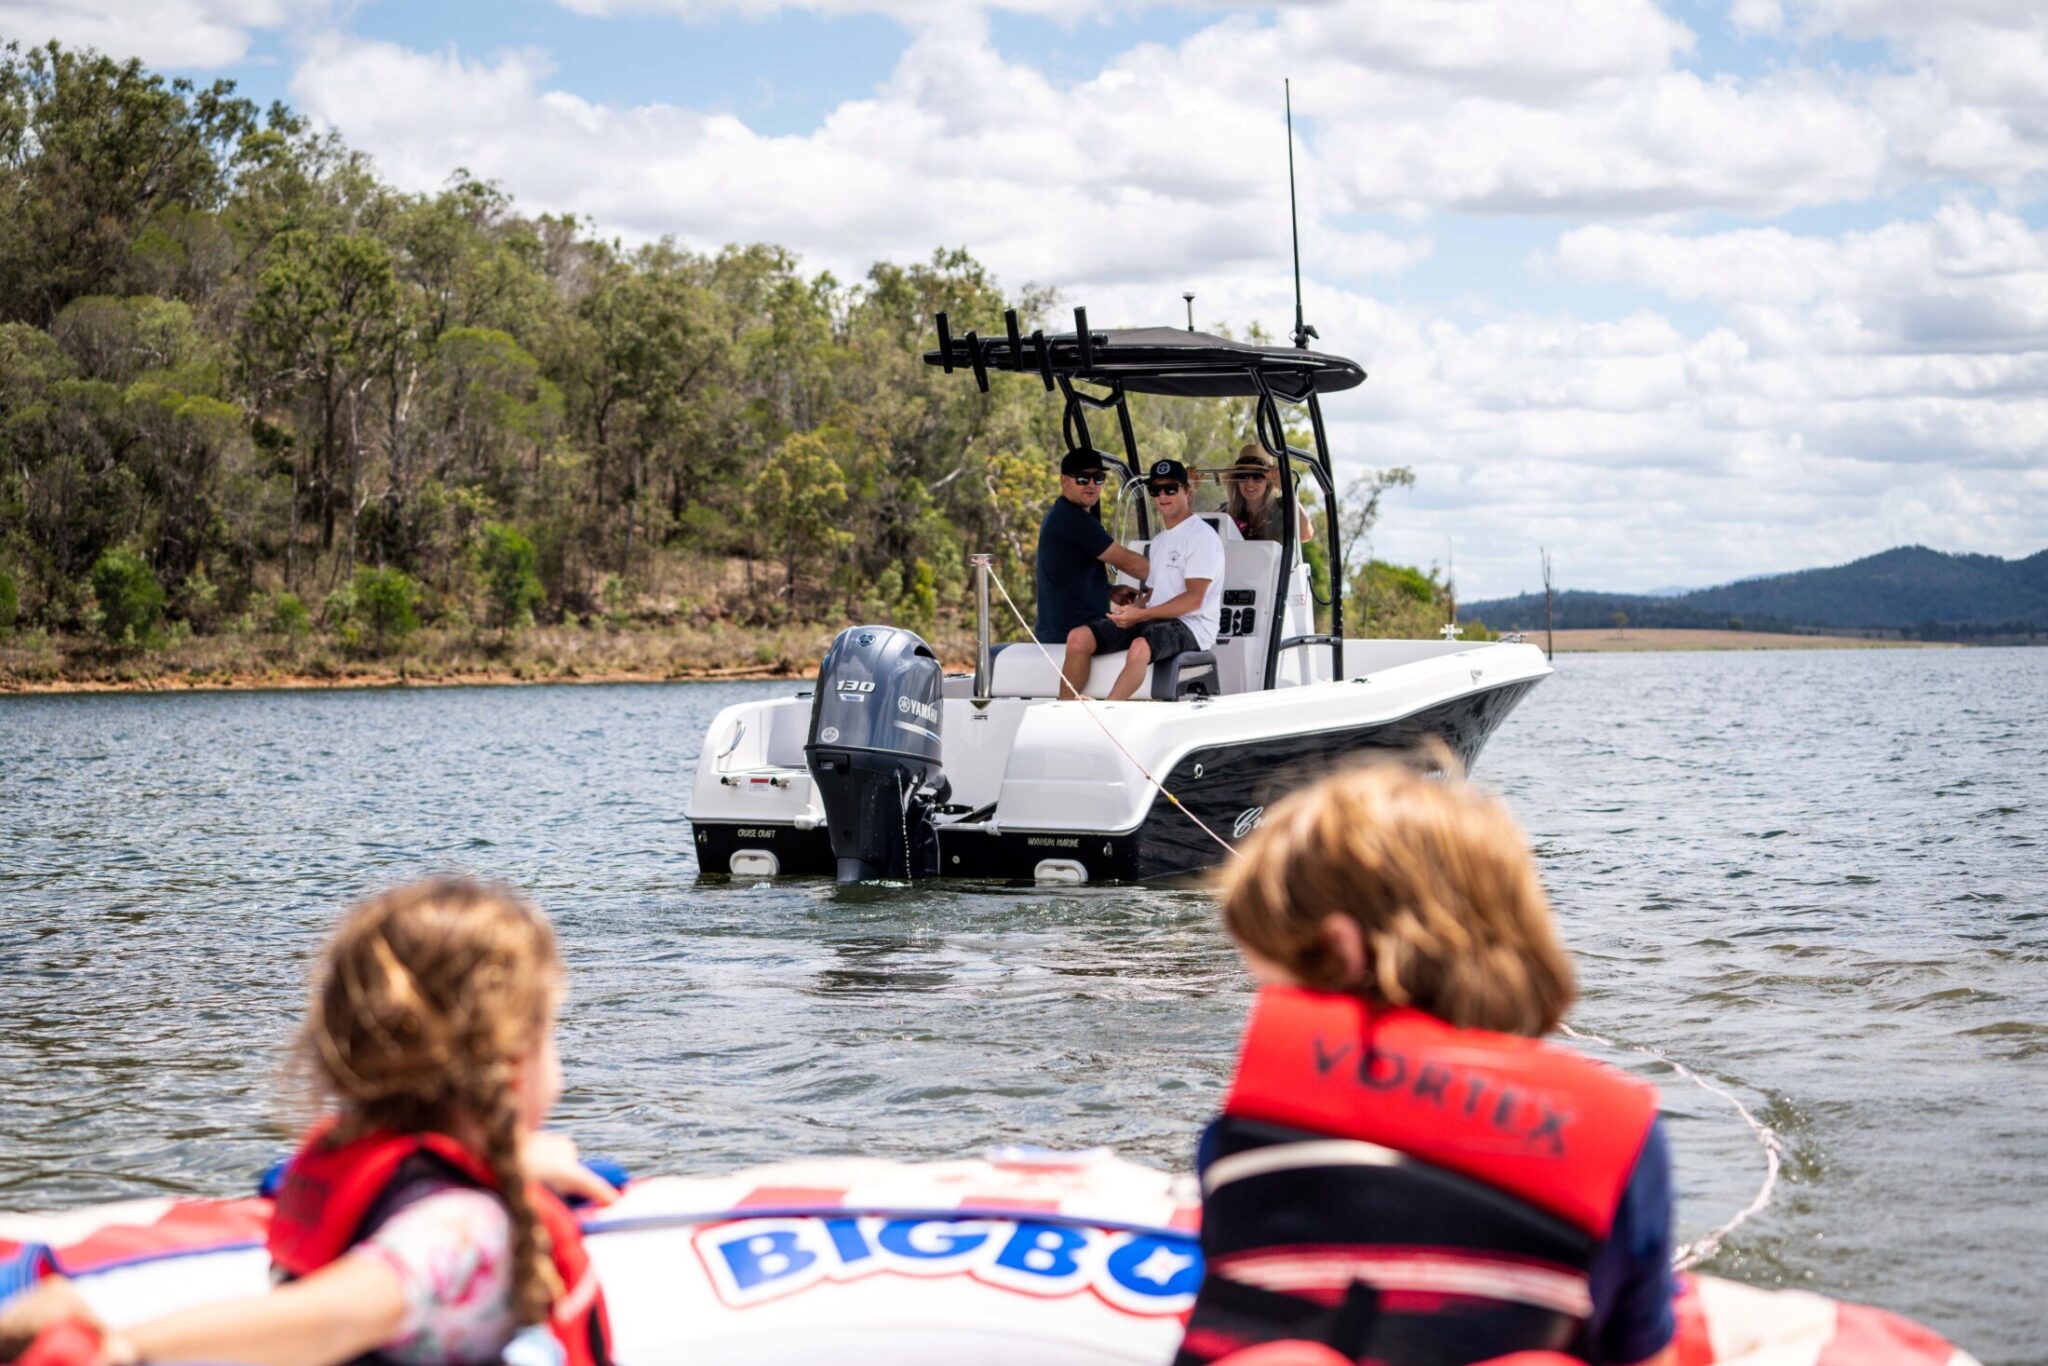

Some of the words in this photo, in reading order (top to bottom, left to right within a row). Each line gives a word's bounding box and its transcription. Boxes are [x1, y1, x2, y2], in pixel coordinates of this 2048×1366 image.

[836, 680, 876, 693] 130
[1312, 1036, 1576, 1157] VORTEX
[716, 1216, 1205, 1296] BIGBO
